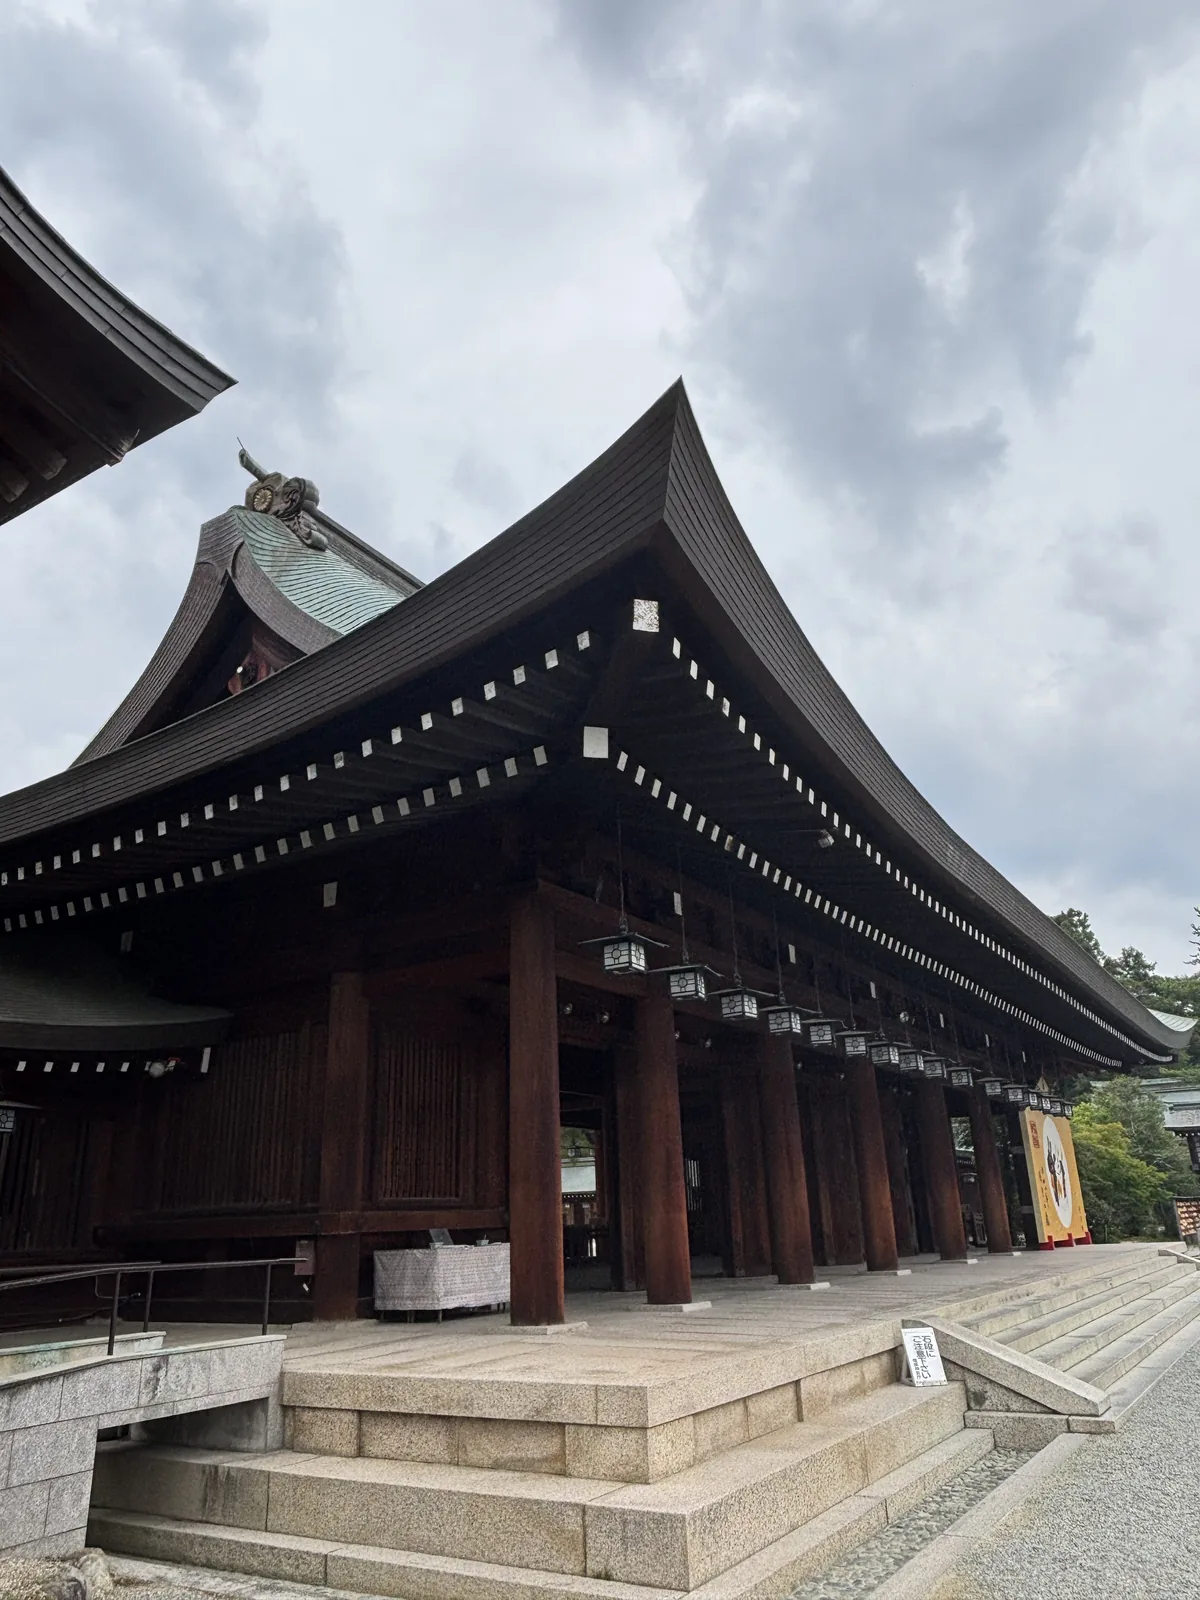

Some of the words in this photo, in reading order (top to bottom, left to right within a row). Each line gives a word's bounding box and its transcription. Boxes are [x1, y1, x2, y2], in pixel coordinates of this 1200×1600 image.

[912, 1335, 931, 1379] ご注意下さい
[921, 1335, 936, 1358] 石段に
